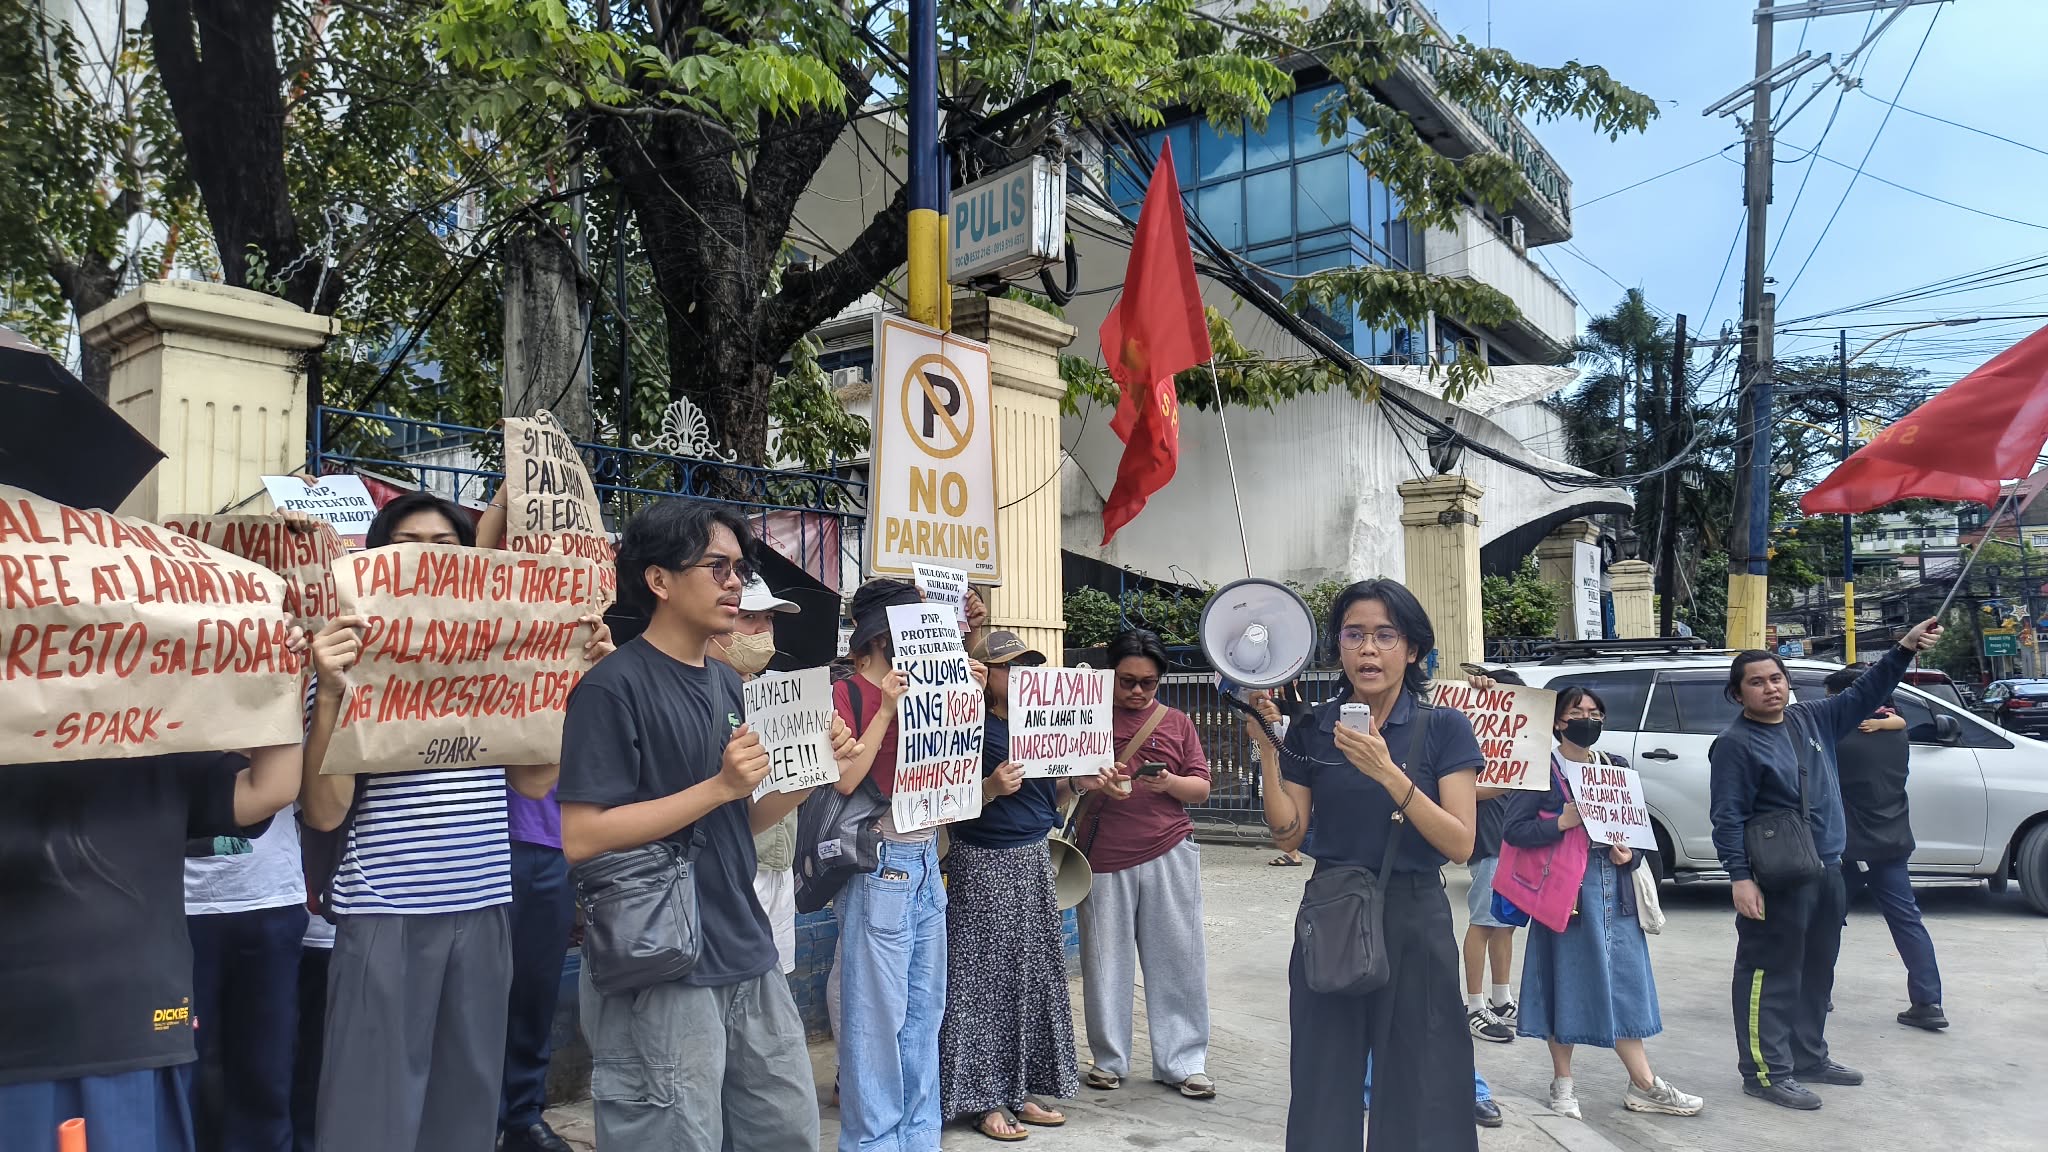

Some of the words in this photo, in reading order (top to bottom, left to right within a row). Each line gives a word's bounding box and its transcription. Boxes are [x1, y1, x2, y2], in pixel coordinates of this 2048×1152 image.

[955, 176, 1025, 249] PULIS
[522, 427, 539, 458] SI
[285, 496, 368, 511] PROTEKTOR
[303, 486, 337, 497] PNP,
[909, 466, 968, 517] NO
[526, 499, 544, 531] SI
[170, 535, 212, 560] SI
[885, 517, 990, 561] PARKING
[92, 564, 126, 604] AT
[124, 554, 231, 605] LAHAT
[228, 571, 272, 605] NG
[353, 551, 490, 598] PALAYAIN
[492, 563, 514, 601] SI
[516, 559, 594, 605] THREE!
[921, 613, 943, 626] PNP,
[0, 623, 148, 681] RESTO
[150, 638, 187, 675] SA
[352, 615, 503, 666] PALAYAIN
[503, 620, 580, 662] LAHAT
[898, 645, 917, 657] NG
[341, 683, 373, 728] NG
[377, 674, 508, 723] INARESTO
[508, 681, 526, 719] SA
[744, 678, 802, 717] PALAYAIN
[1019, 670, 1104, 708] PALAYAIN
[1432, 684, 1515, 712] IKULONG
[904, 691, 943, 732] ANG
[946, 689, 983, 726] KORAP
[1024, 710, 1046, 729] ANG
[1050, 709, 1076, 726] LAHAT
[1080, 709, 1093, 725] NG
[763, 709, 832, 747] KASAMANG
[905, 730, 948, 764] HINDI
[949, 726, 982, 756] ANG
[1011, 733, 1068, 762] INARESTO
[1078, 730, 1113, 757] RALLY!
[798, 770, 829, 787] SPARK
[1581, 765, 1627, 788] PALAYAIN
[1596, 788, 1620, 805] LAHAT
[153, 1006, 189, 1022] DICKIES
